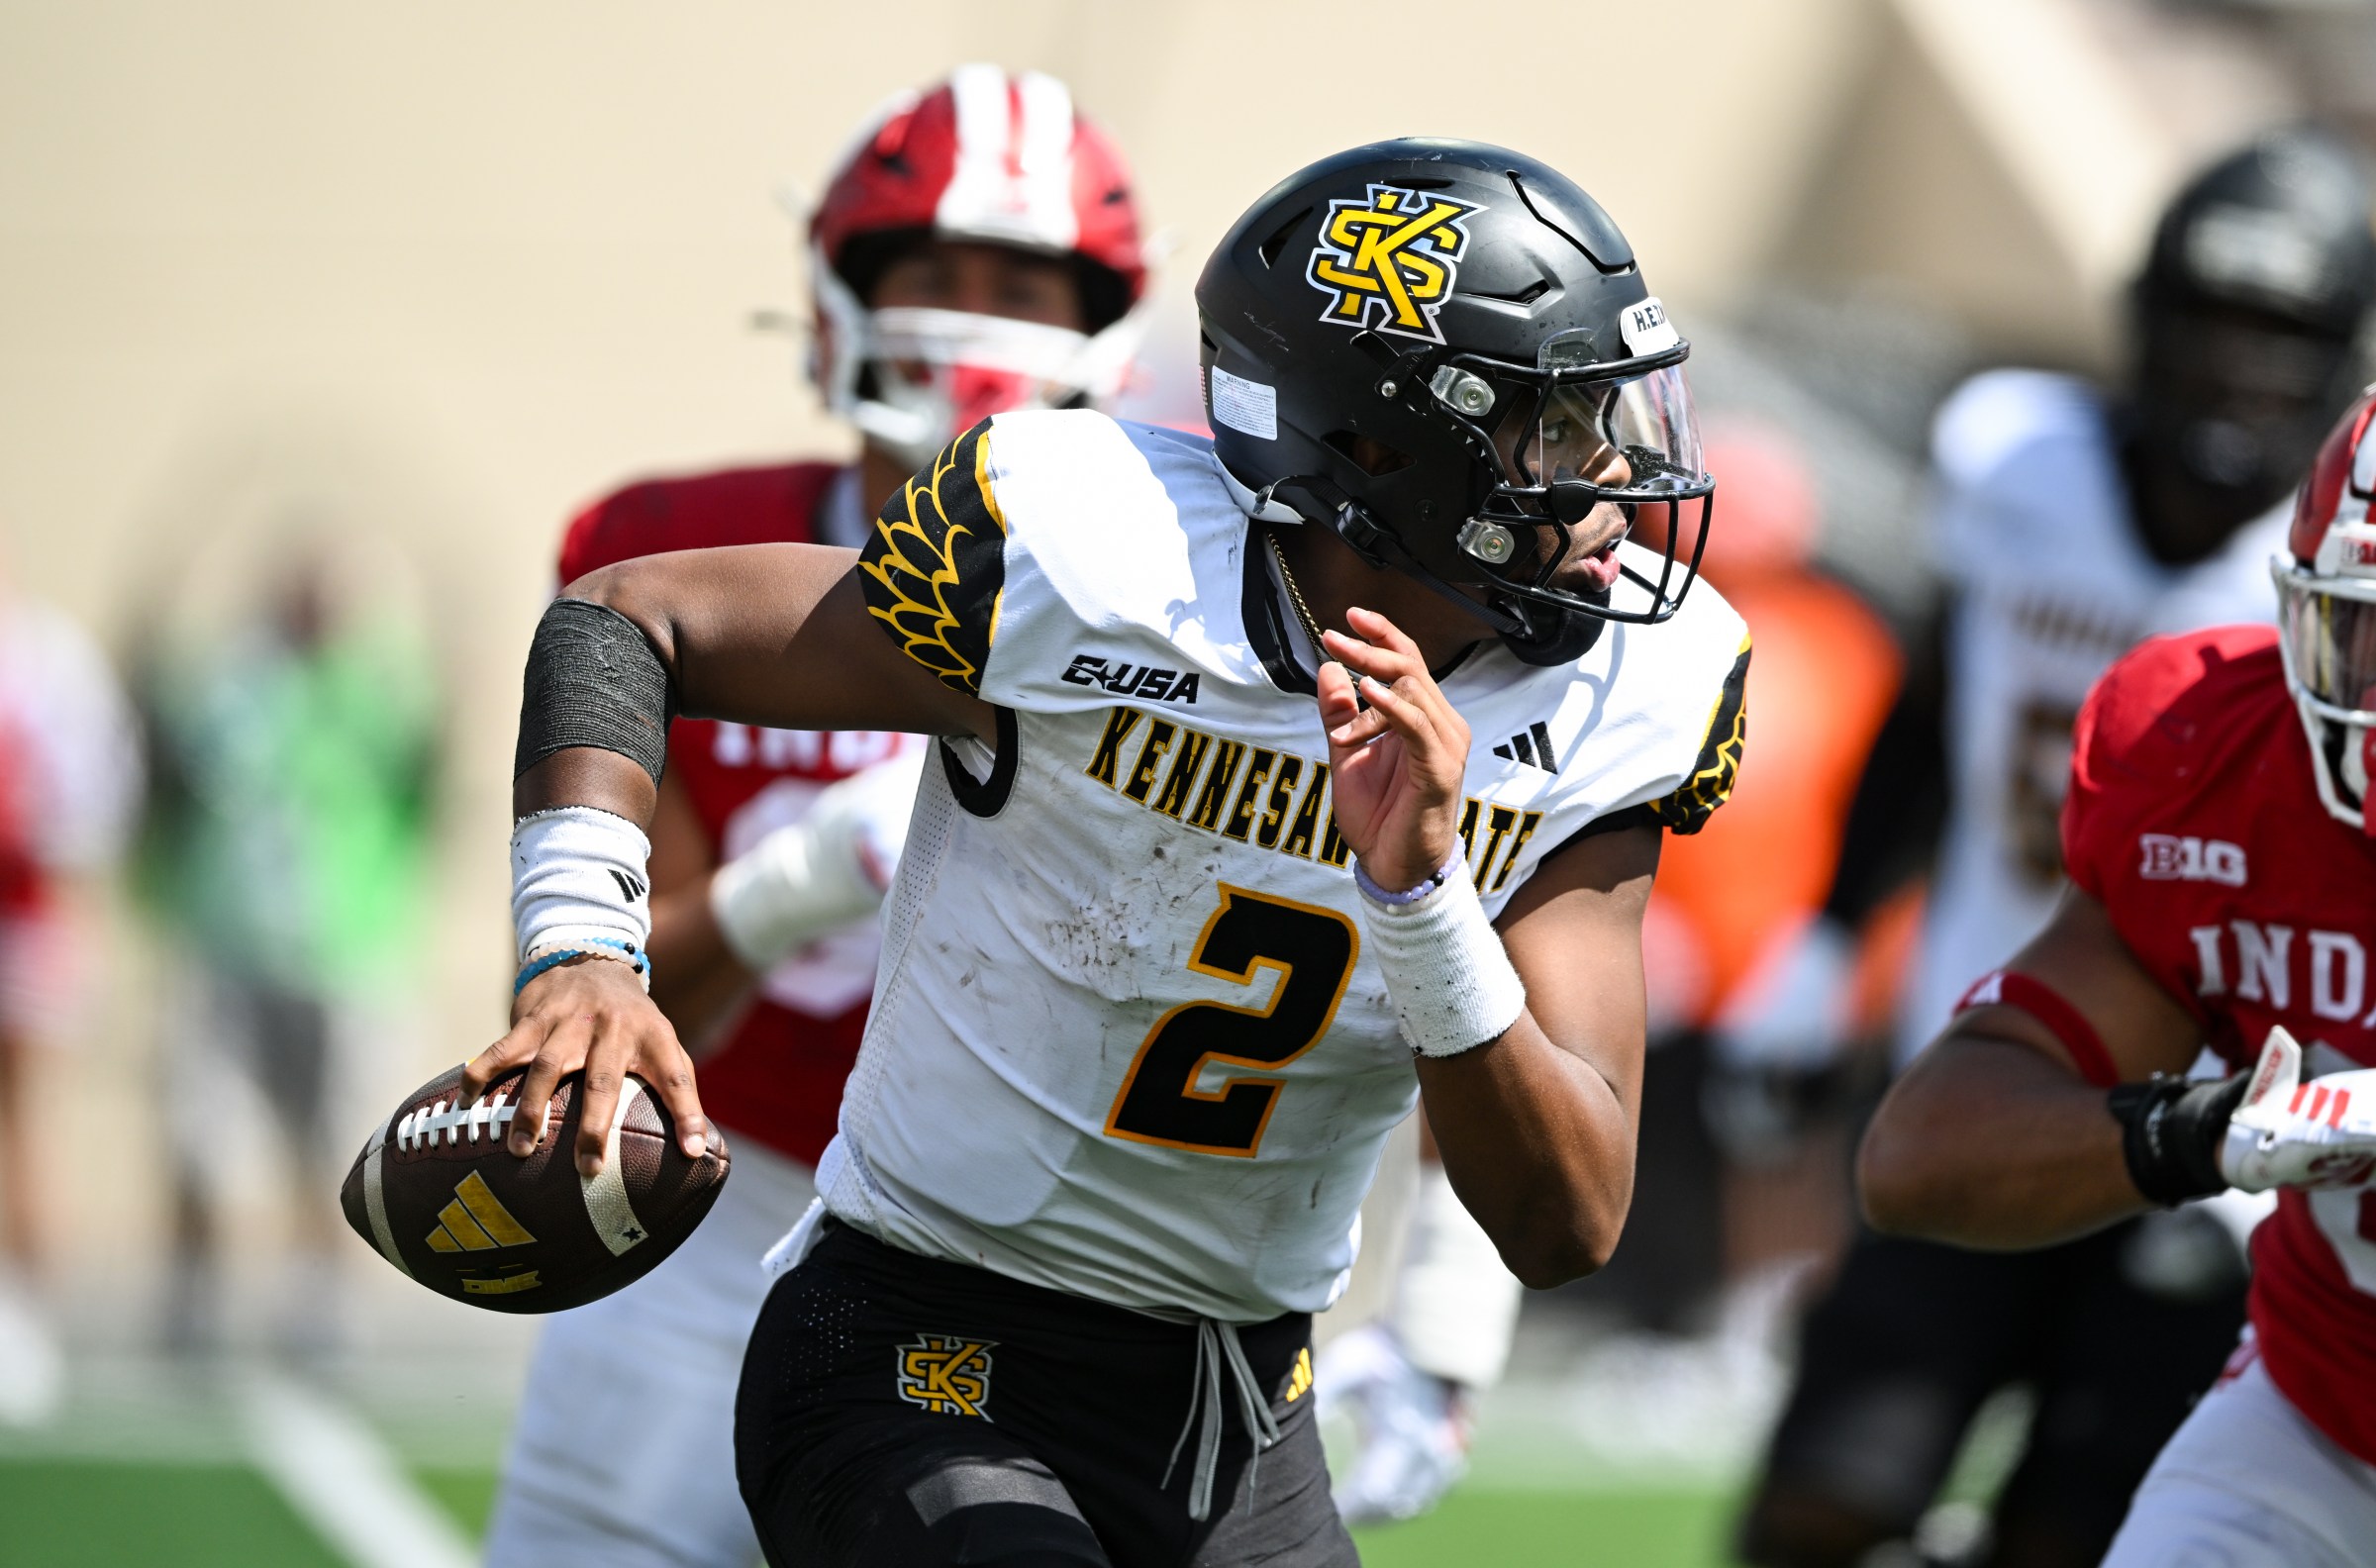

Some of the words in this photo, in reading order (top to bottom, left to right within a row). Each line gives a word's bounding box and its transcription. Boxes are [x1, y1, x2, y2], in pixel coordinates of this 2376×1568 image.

[1227, 376, 1250, 389] WARNING
[1103, 880, 1361, 1158] 2
[2189, 918, 2376, 1029] IND
